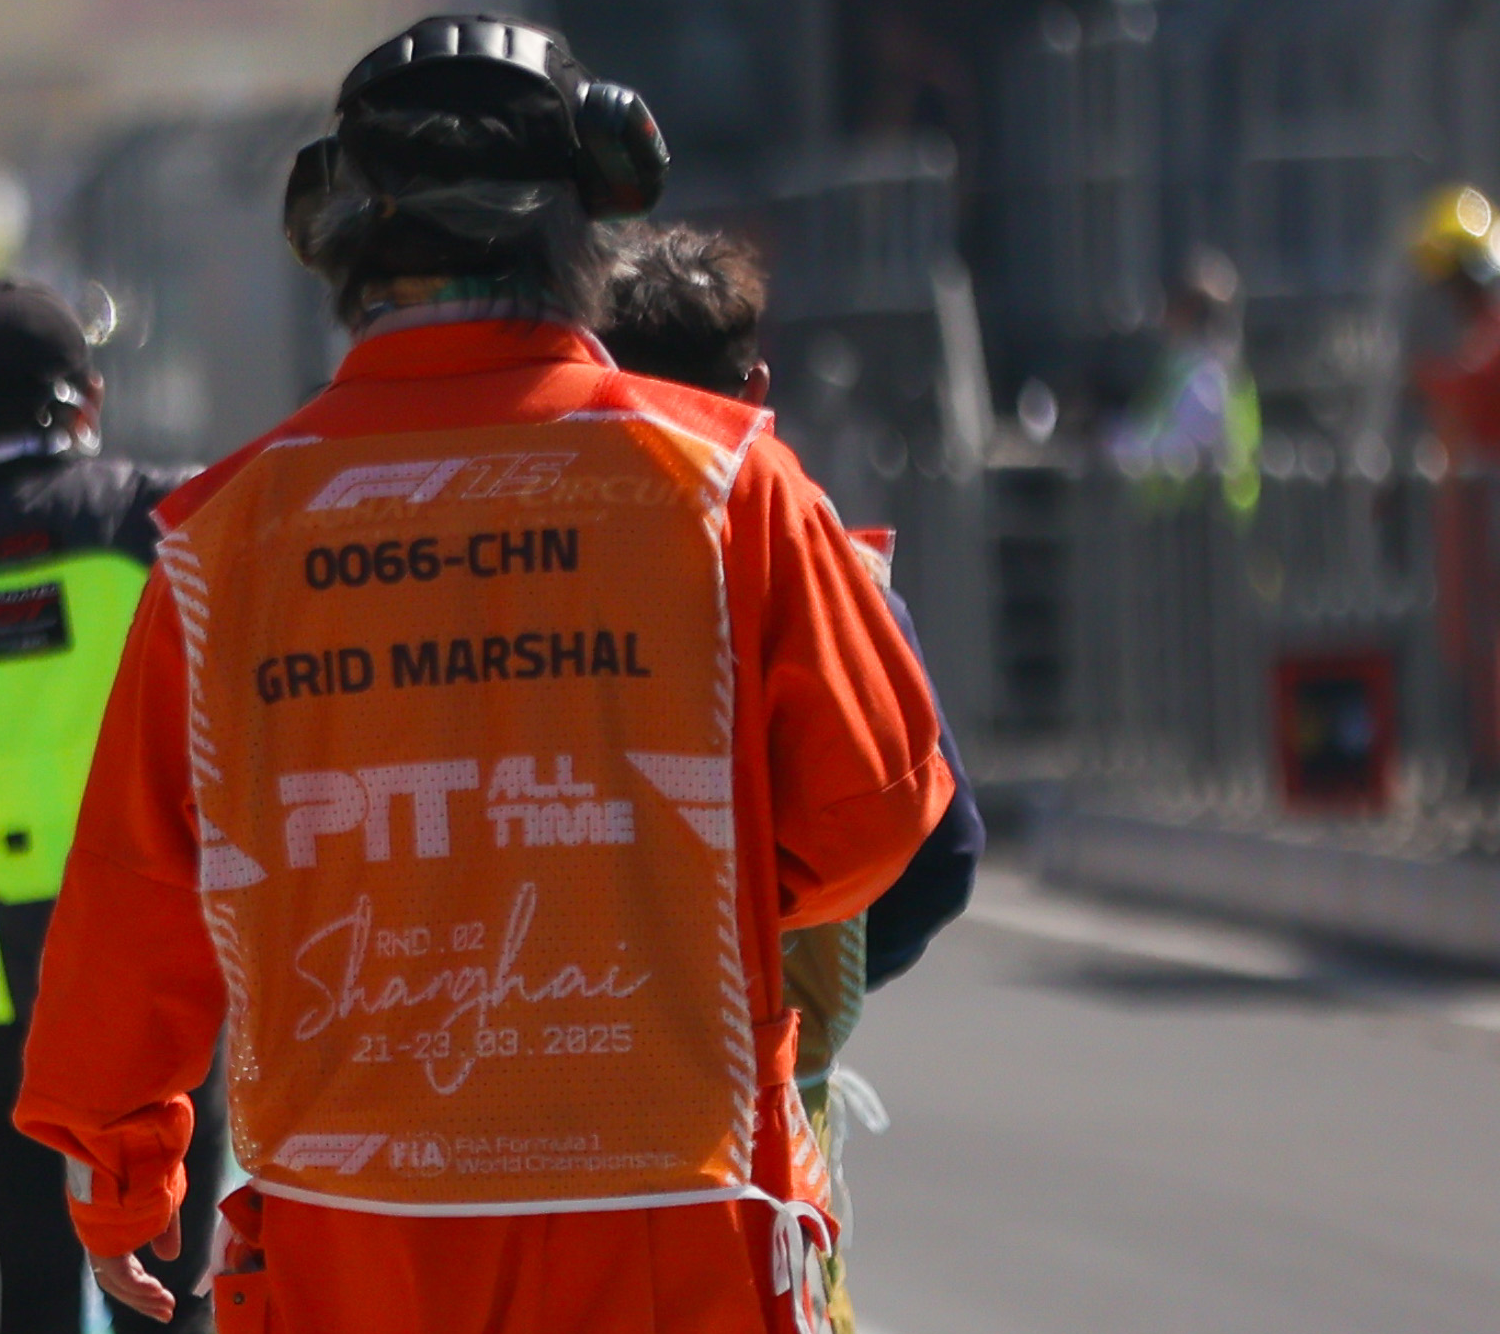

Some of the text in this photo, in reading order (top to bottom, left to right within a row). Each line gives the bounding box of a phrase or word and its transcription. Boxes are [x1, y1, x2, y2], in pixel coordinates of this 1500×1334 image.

[303, 527, 579, 591] 0066-CHN
[255, 630, 653, 705] GRID MARSHAL
[278, 758, 480, 868] PIT
[294, 880, 653, 1095] Shanghai
